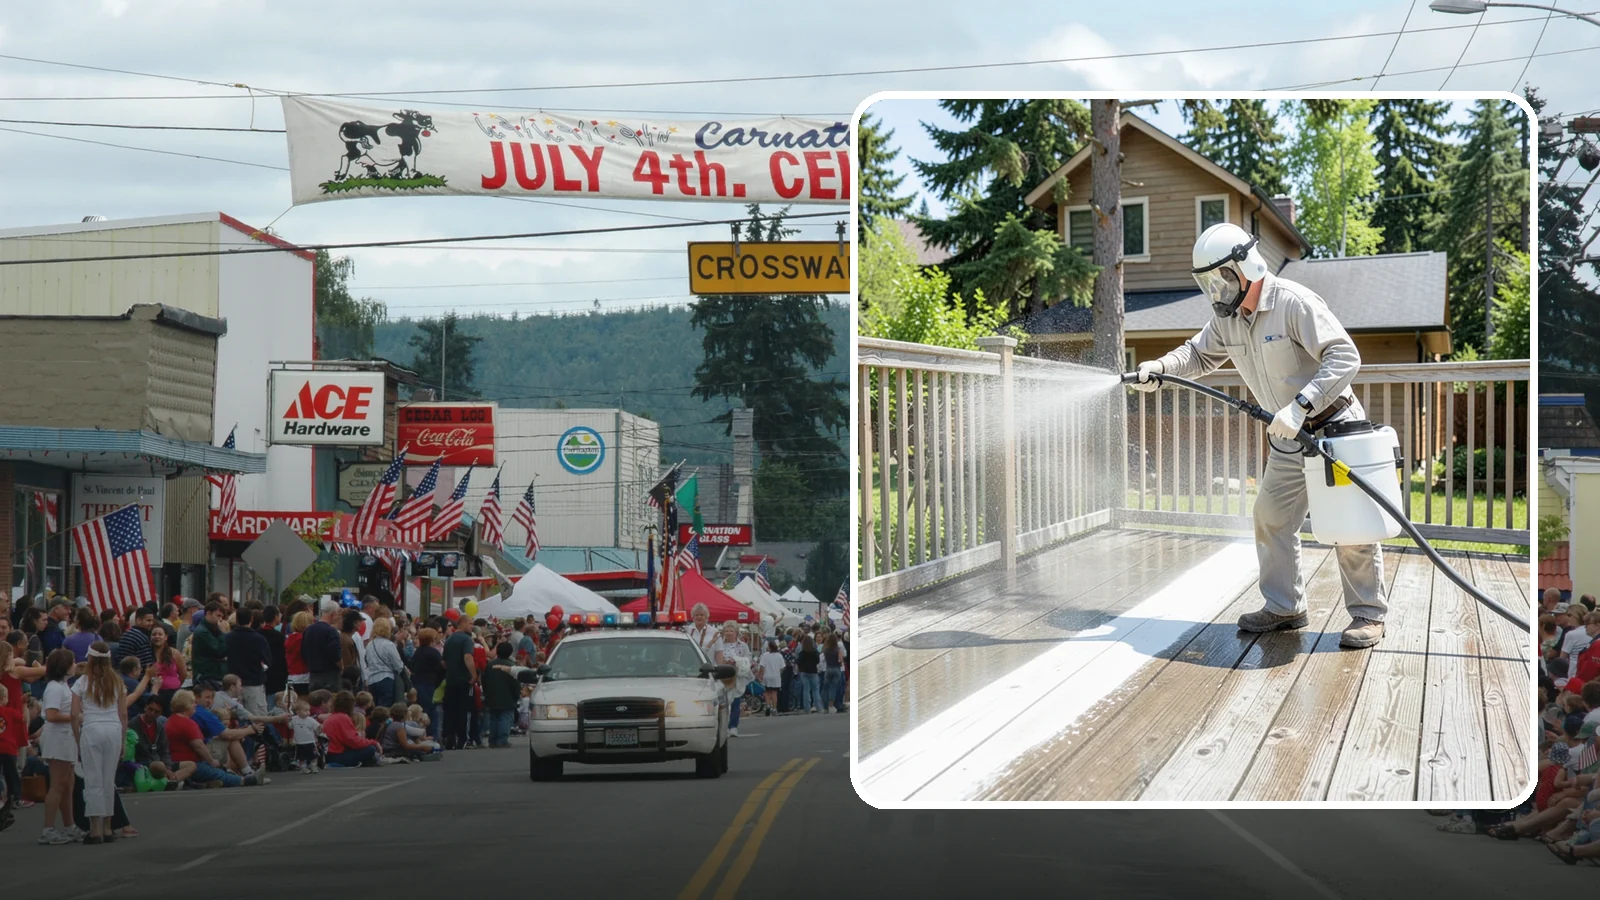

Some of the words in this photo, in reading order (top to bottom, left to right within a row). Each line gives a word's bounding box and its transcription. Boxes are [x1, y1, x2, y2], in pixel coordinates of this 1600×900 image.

[481, 140, 605, 192] JULY
[632, 149, 746, 198] 4th.
[696, 254, 850, 280] CROSSWA
[282, 379, 374, 420] ACE
[405, 409, 453, 423] CEDAR
[460, 409, 485, 422] LOG
[283, 421, 371, 437] Hardware
[416, 428, 477, 447] Coca-Cola
[96, 484, 124, 495] Vincent
[126, 485, 136, 495] de
[137, 485, 155, 496] Paul
[81, 503, 154, 522] THT
[688, 526, 741, 535] CRNATION
[699, 535, 730, 543] GLASS
